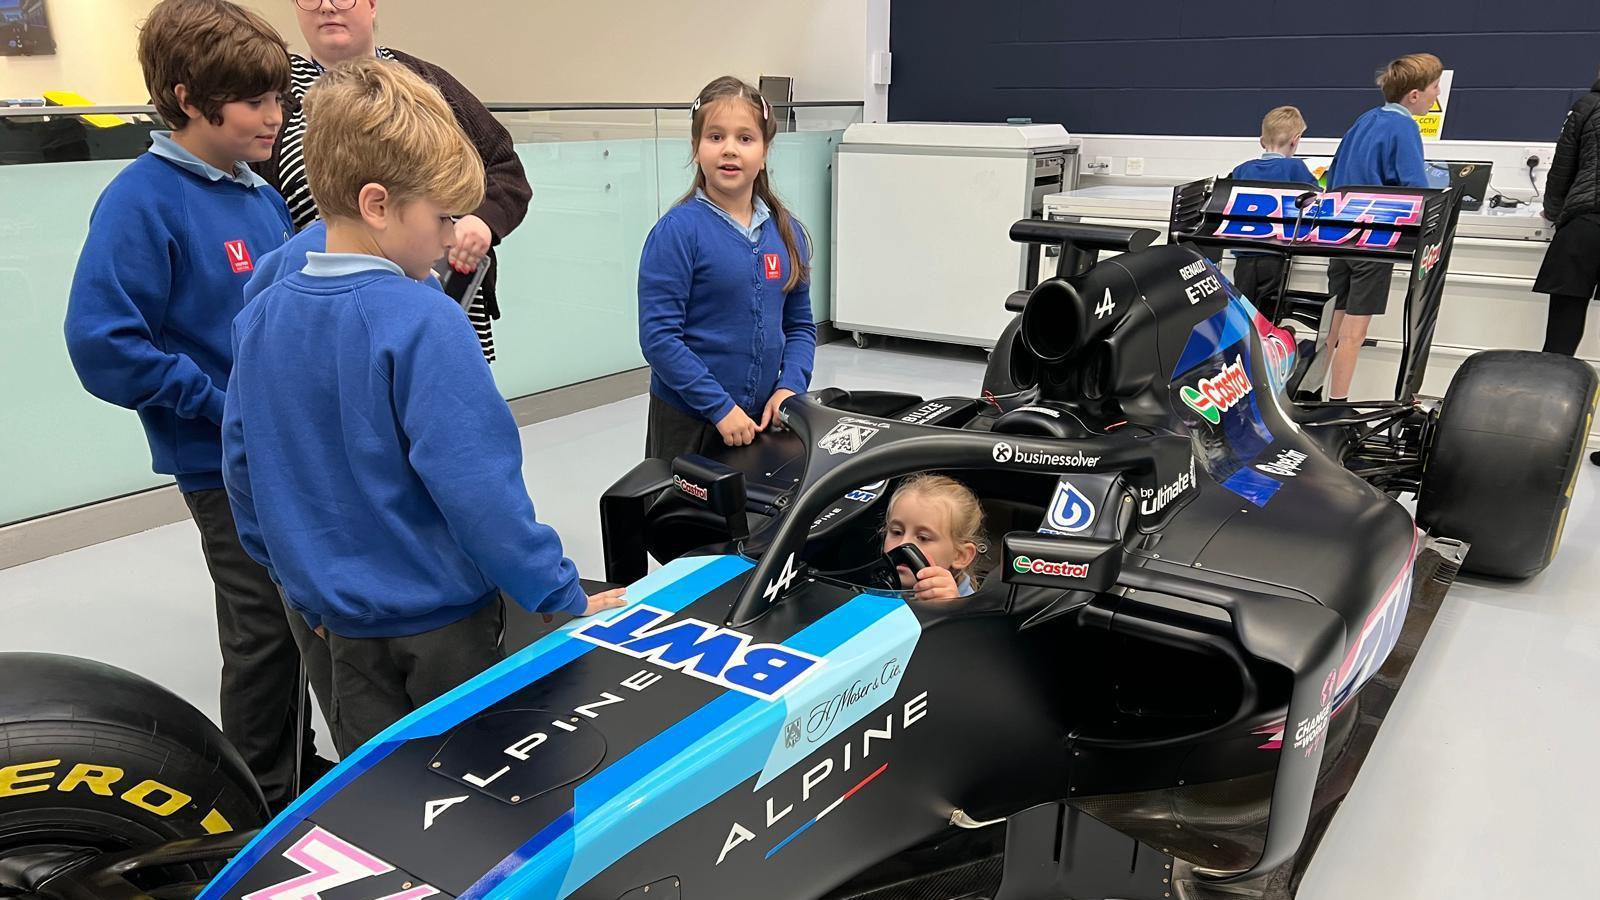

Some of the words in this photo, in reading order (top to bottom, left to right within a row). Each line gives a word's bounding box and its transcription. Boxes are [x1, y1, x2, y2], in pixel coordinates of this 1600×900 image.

[1213, 187, 1423, 248] BWT
[1184, 274, 1222, 305] E-TECH
[1198, 353, 1253, 413] Castrol
[901, 402, 944, 422] BILIZE
[1014, 446, 1101, 468] businessolver
[679, 478, 708, 501] Castrol
[845, 489, 878, 503] WT
[1140, 487, 1155, 499] bp
[1141, 472, 1190, 516] ultimate
[809, 507, 843, 530] LPINE
[1030, 558, 1090, 579] Castrol
[568, 603, 829, 702] BWT
[423, 668, 663, 831] ALPINE
[0, 759, 193, 817] ERO
[715, 690, 928, 866] ALPINE
